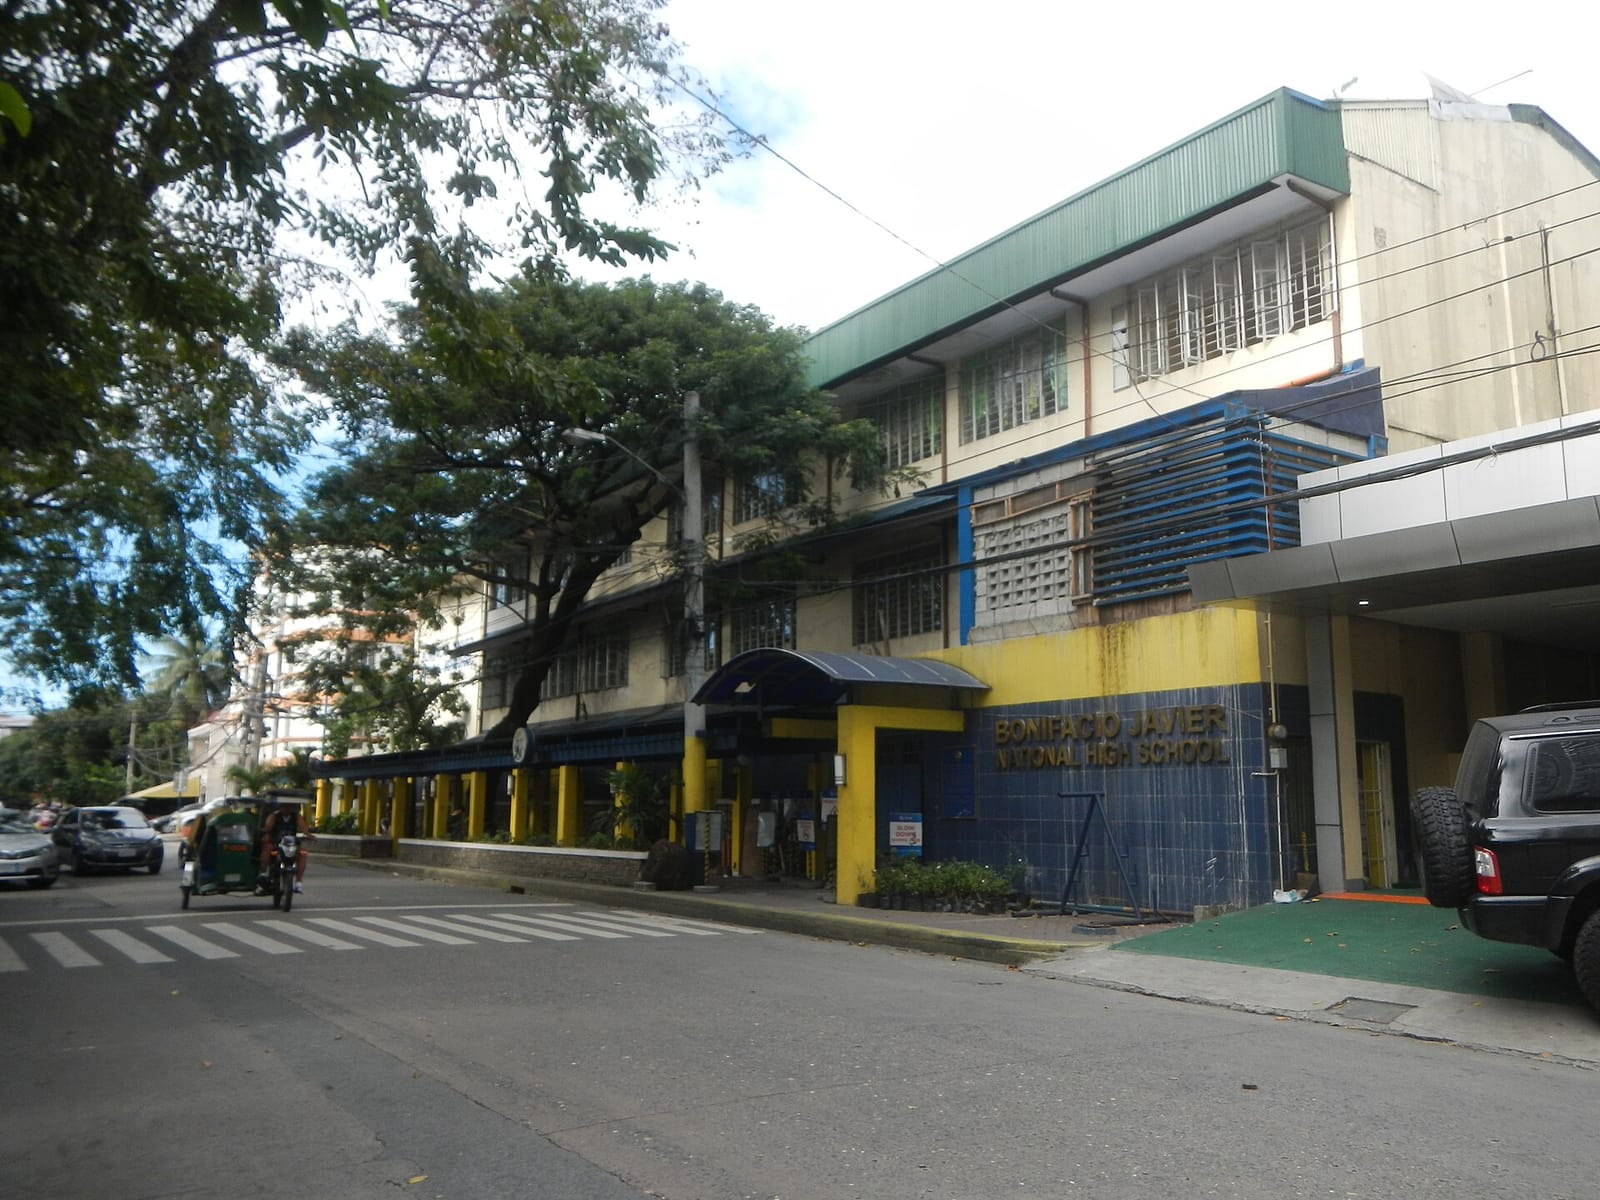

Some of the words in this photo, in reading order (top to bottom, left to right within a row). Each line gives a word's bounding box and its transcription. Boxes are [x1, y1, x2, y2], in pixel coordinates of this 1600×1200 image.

[994, 711, 1121, 744] BONIFACIO
[1128, 704, 1228, 738] JAVIER
[1086, 741, 1131, 766] HIGH
[1136, 738, 1230, 765] SCHOOL
